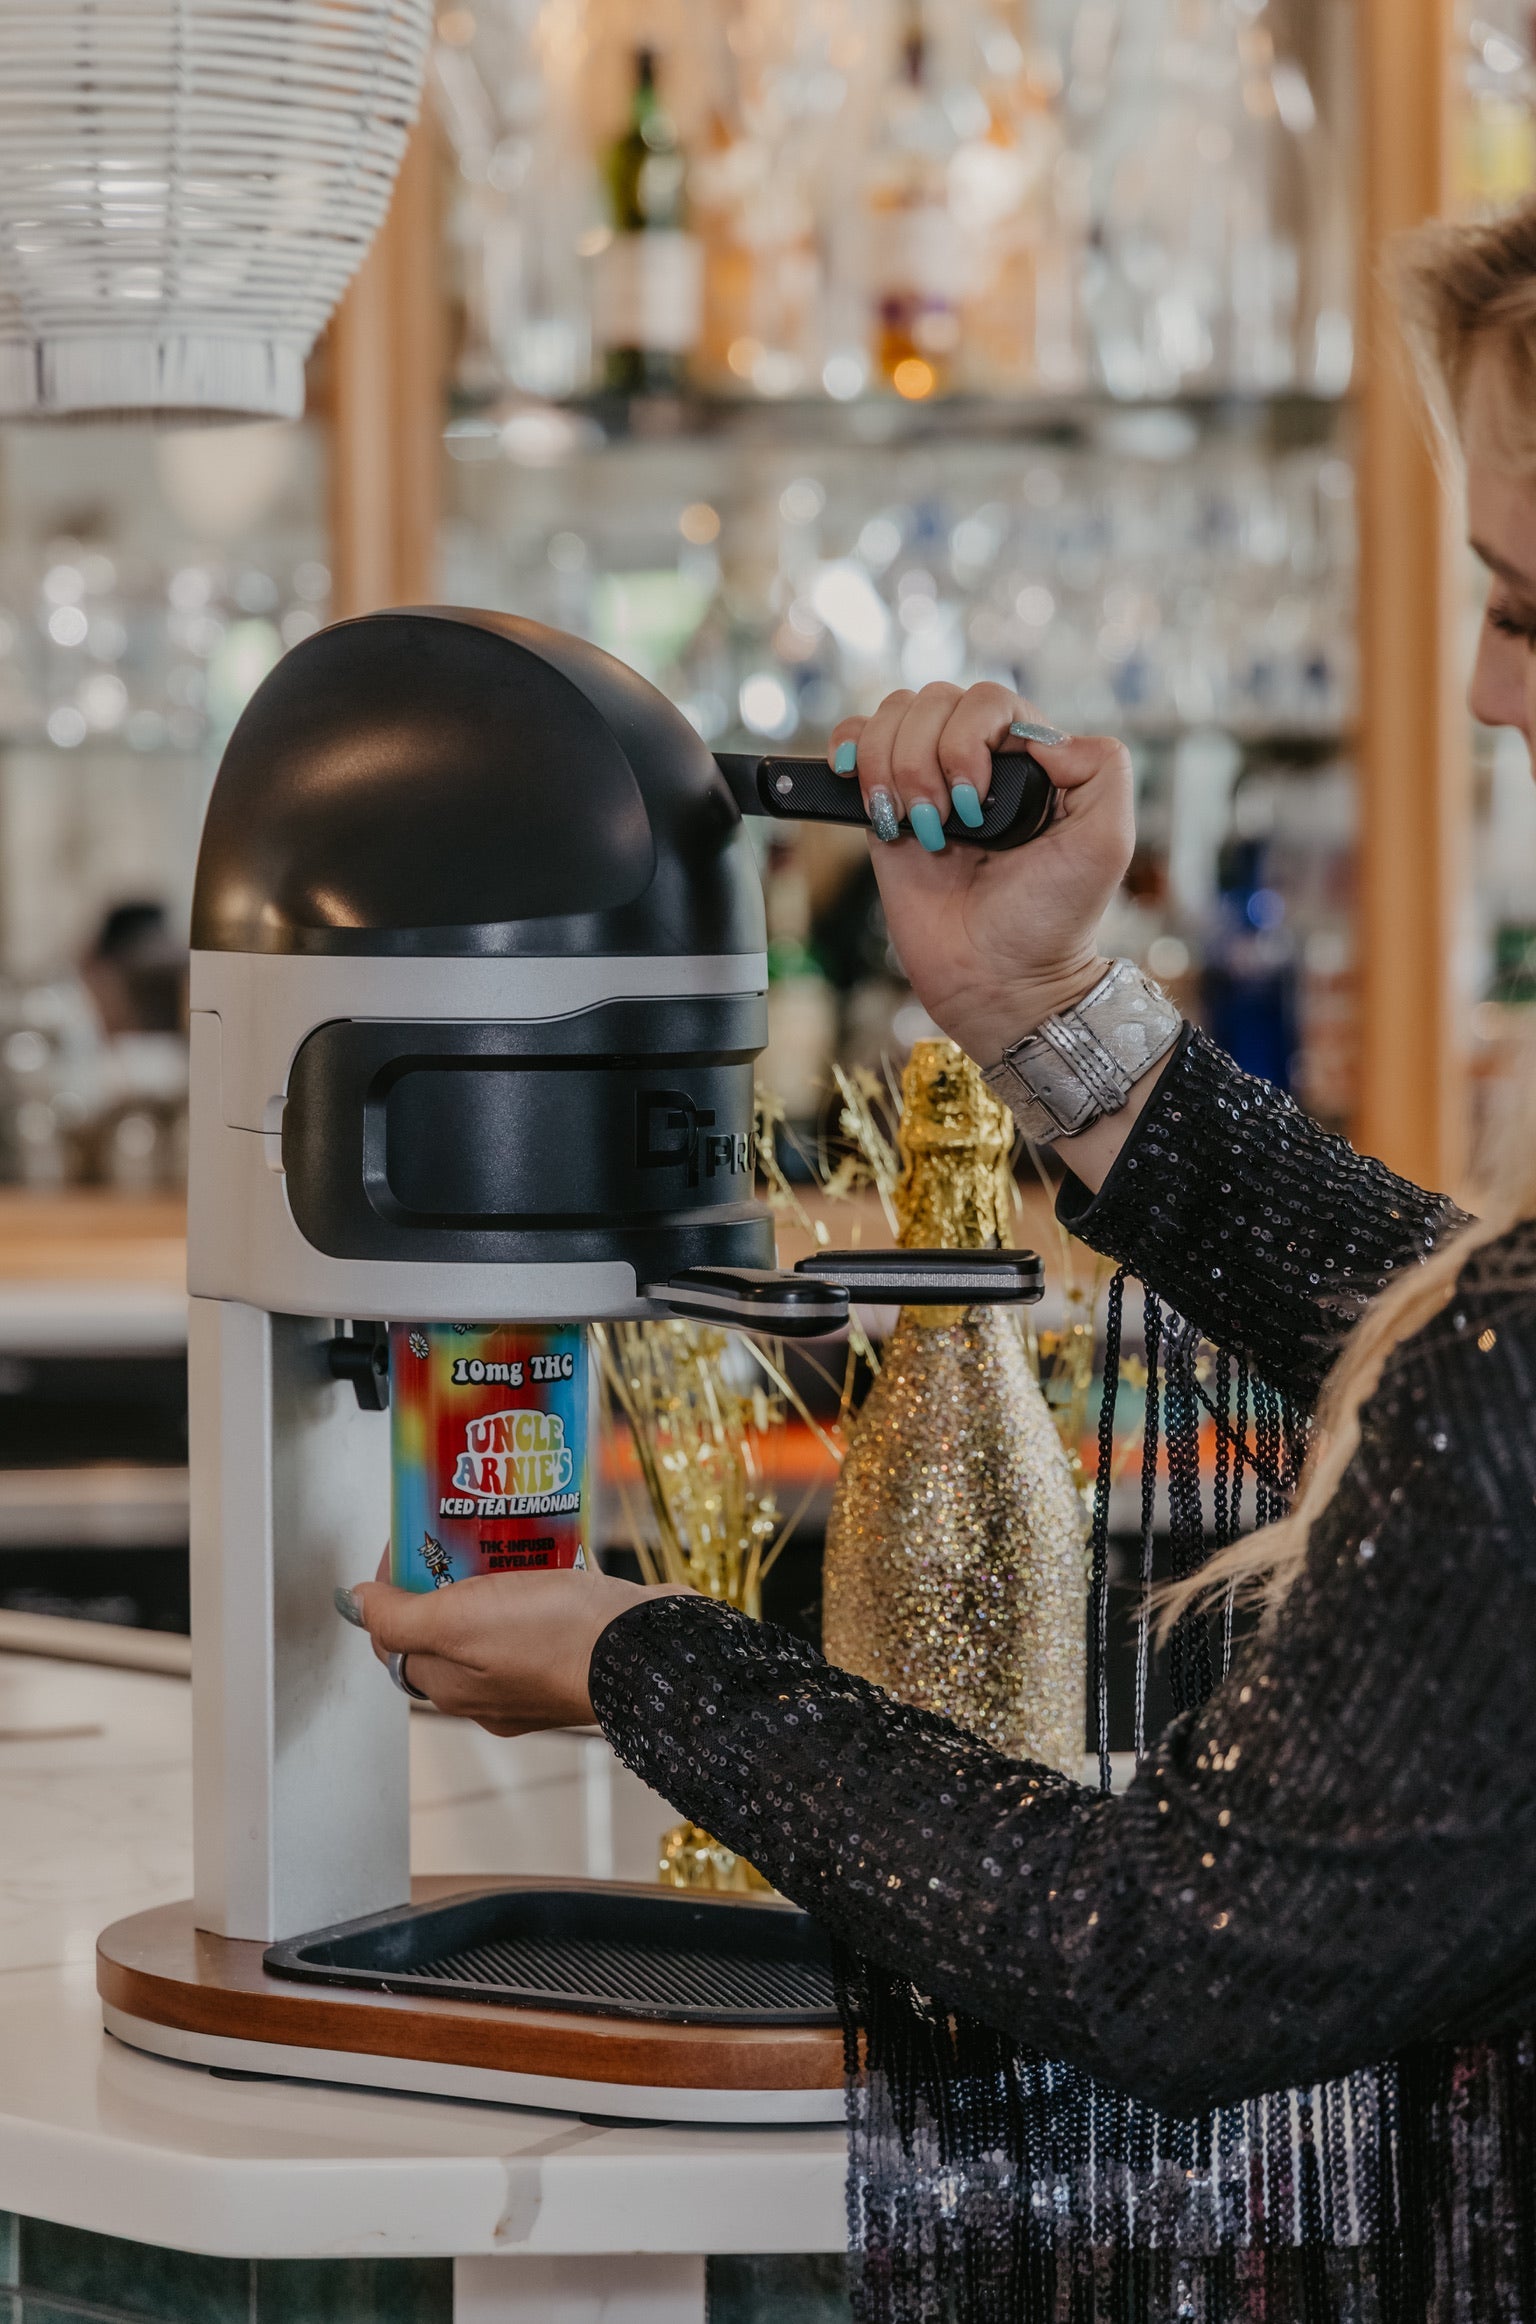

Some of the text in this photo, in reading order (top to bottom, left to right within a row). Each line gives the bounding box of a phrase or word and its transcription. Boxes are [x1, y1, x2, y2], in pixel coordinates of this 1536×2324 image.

[453, 1354, 573, 1387] 10mg THC
[469, 1414, 563, 1454] UNCLE
[456, 1451, 571, 1495] ARNIE'S
[440, 1493, 580, 1516] ICED TEA LEMONADE
[489, 1554, 549, 1569] BEVERAGE
